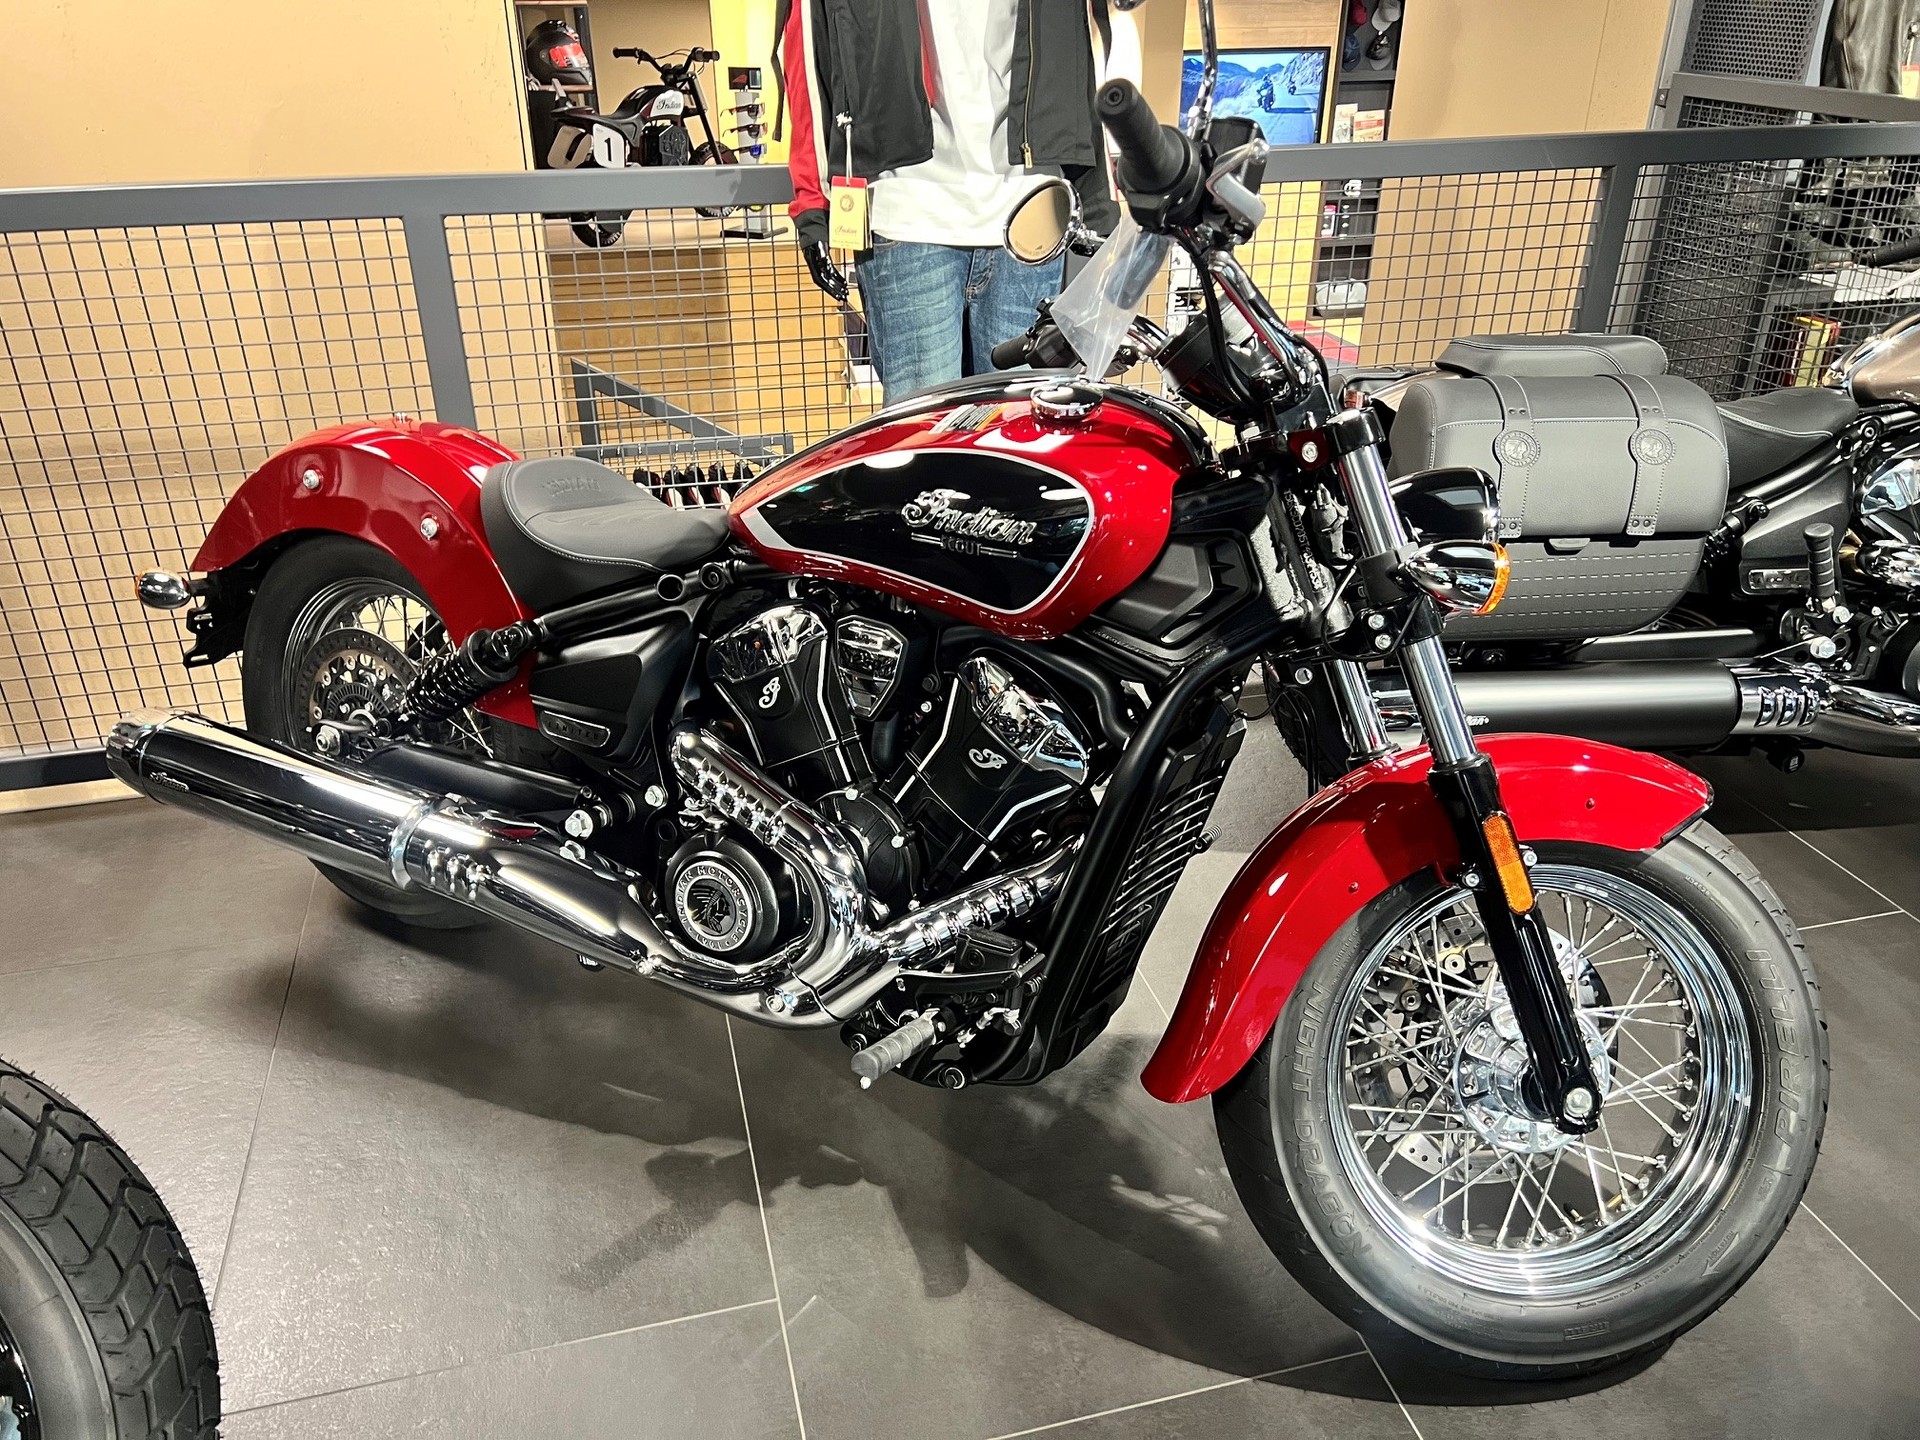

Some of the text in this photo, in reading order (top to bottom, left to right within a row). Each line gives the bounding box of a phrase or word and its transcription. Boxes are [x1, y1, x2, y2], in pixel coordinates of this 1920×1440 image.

[604, 137, 613, 162] 1
[901, 489, 1037, 545] Indian
[940, 534, 981, 556] SCOUT
[547, 720, 600, 741] LIMITED
[676, 865, 749, 942] INDIAN MOTORCYCLE
[1745, 949, 1800, 1148] PIRELLI
[1291, 980, 1372, 1258] NIGHT DRAGON
